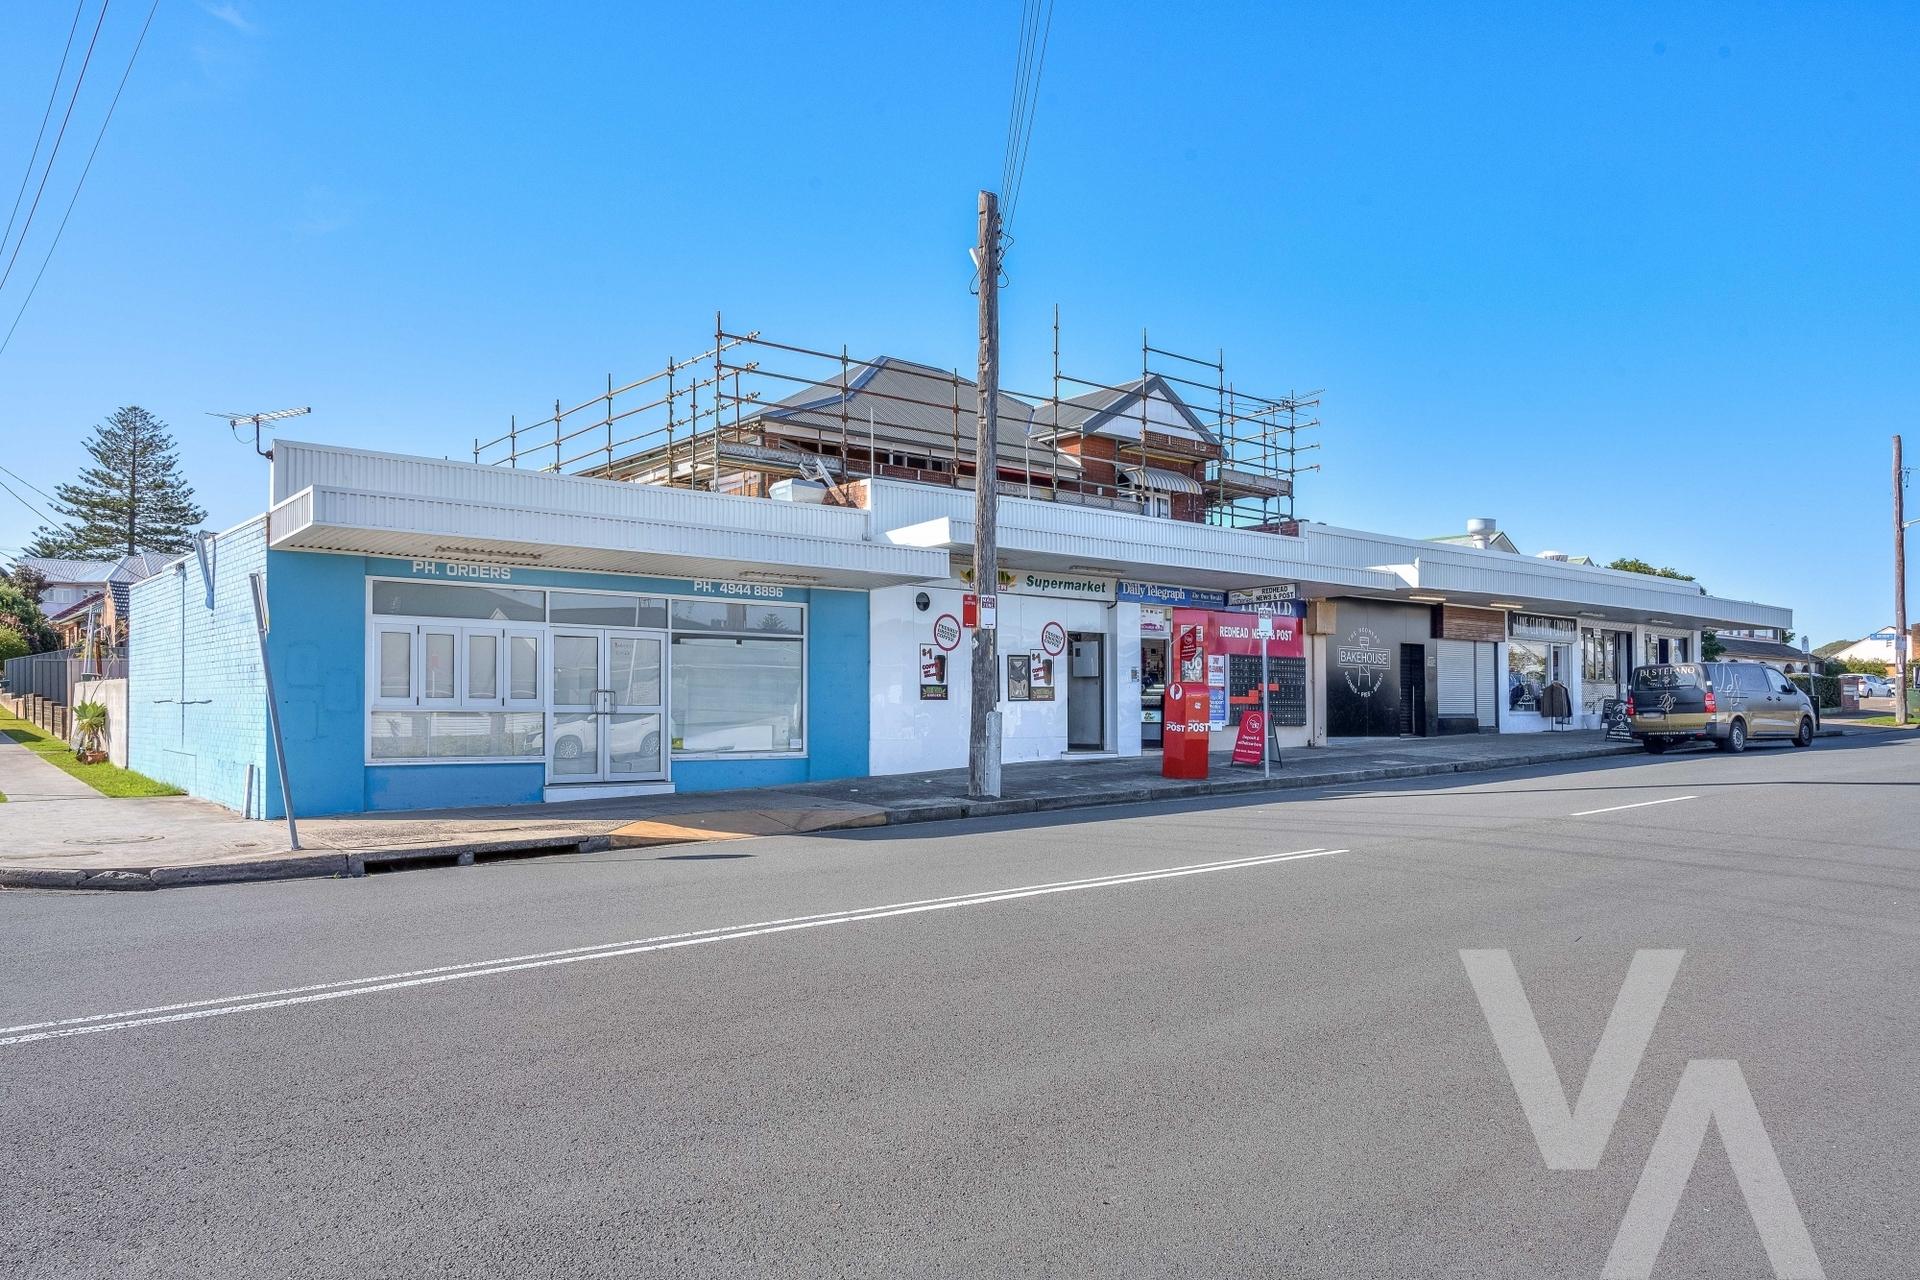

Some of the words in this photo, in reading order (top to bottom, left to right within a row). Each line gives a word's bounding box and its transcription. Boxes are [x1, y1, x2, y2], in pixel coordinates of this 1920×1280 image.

[413, 561, 440, 575] PH.
[446, 563, 511, 579] ORDERS
[694, 580, 715, 593] PH.
[720, 583, 751, 595] 4944
[754, 585, 784, 598] 8896
[1026, 574, 1106, 593] Supermarket
[1261, 585, 1288, 595] REDHEAD
[1123, 582, 1146, 598] Daily
[1145, 585, 1185, 601] Telegraph
[1255, 594, 1272, 602] NEWS
[1279, 591, 1294, 600] POST
[1220, 626, 1249, 639] REDHEAD
[1252, 628, 1271, 640] NE
[1276, 630, 1293, 641] POST
[922, 648, 933, 660] $1
[1340, 650, 1387, 665] BAKEHOUSE
[1166, 723, 1186, 732] POST
[1187, 722, 1211, 732] POST
